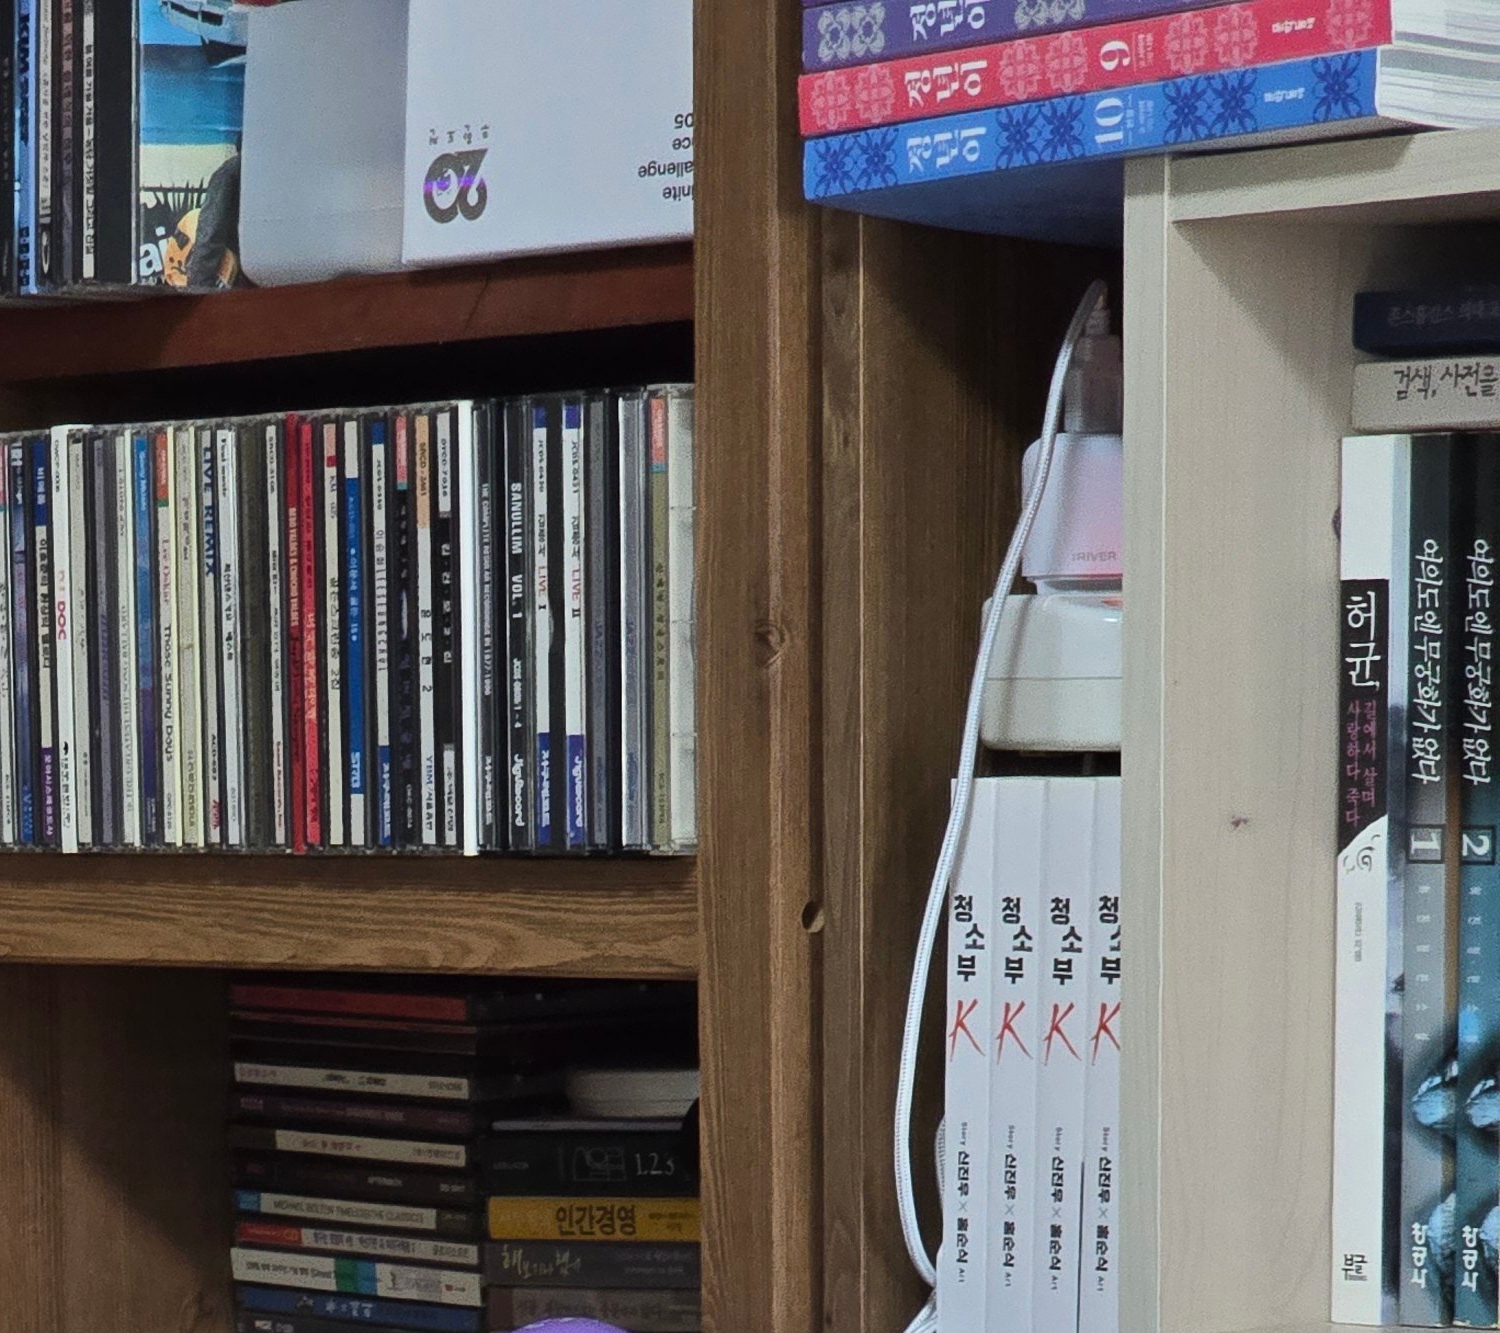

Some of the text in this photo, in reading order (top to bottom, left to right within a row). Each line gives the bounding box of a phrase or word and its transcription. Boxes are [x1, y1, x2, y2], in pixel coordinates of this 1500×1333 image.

[904, 60, 988, 108] 정년이
[1099, 40, 1131, 71] 9
[905, 126, 986, 174] 정년이
[1094, 97, 1124, 144] 10
[1394, 366, 1437, 401] 검색,
[203, 447, 215, 577] LIVE REMIX
[510, 483, 523, 554] SANULLIM
[289, 529, 298, 557] VALDES
[511, 574, 523, 606] VOL.
[538, 566, 547, 598] LIVE
[571, 568, 581, 602] LIVE
[1411, 537, 1444, 633] 여의도엔
[58, 600, 67, 640] DOC
[290, 599, 299, 626] VALDES
[164, 624, 172, 667] Those
[164, 672, 172, 719] Sunny
[1411, 636, 1444, 733] 무궁화가
[1461, 538, 1497, 859] 여의도엔 무궁화가 없다 2
[165, 725, 173, 763] Days
[1346, 700, 1360, 781] 사랑하다
[1363, 700, 1377, 762] 길에서
[1411, 738, 1443, 785] 없다
[1410, 832, 1439, 858] 1
[953, 894, 986, 984] 청소부
[1001, 895, 1035, 985] 청소부
[1050, 896, 1084, 987] 청소부
[949, 997, 987, 1066] K
[995, 999, 1035, 1067] K
[1044, 1001, 1084, 1068] K
[957, 1150, 970, 1201] 신진우
[1004, 1153, 1017, 1201] 신진우
[1051, 1156, 1064, 1203] 신진우
[1098, 1156, 1111, 1204] 신진우
[555, 1204, 637, 1236] 인간경영
